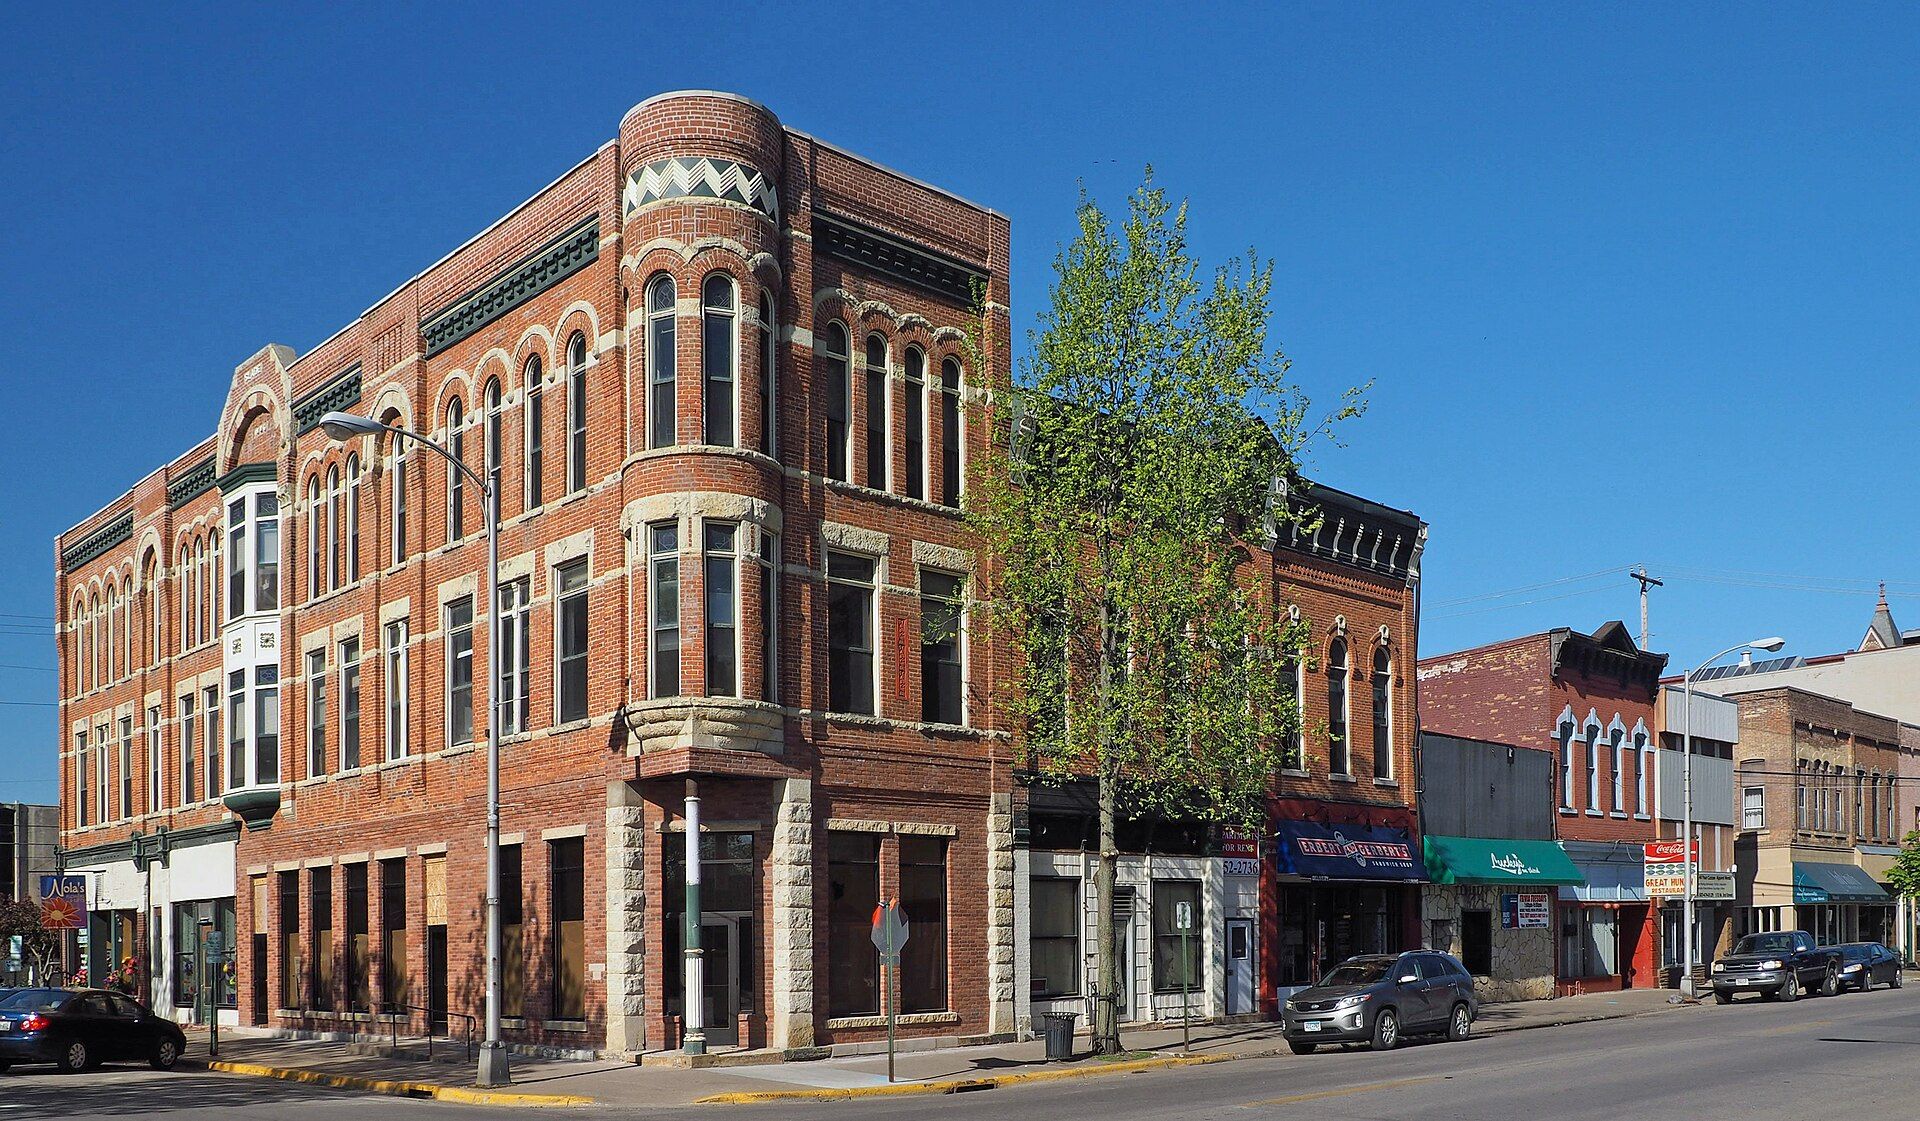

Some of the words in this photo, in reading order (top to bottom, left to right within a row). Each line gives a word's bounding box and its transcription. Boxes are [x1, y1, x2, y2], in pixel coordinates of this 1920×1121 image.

[1301, 841, 1342, 854] ERBERT
[1358, 844, 1409, 857] GERBERT'S
[1491, 853, 1524, 875] Lucky's
[41, 877, 85, 899] Nola's
[1646, 878, 1668, 887] GREAT
